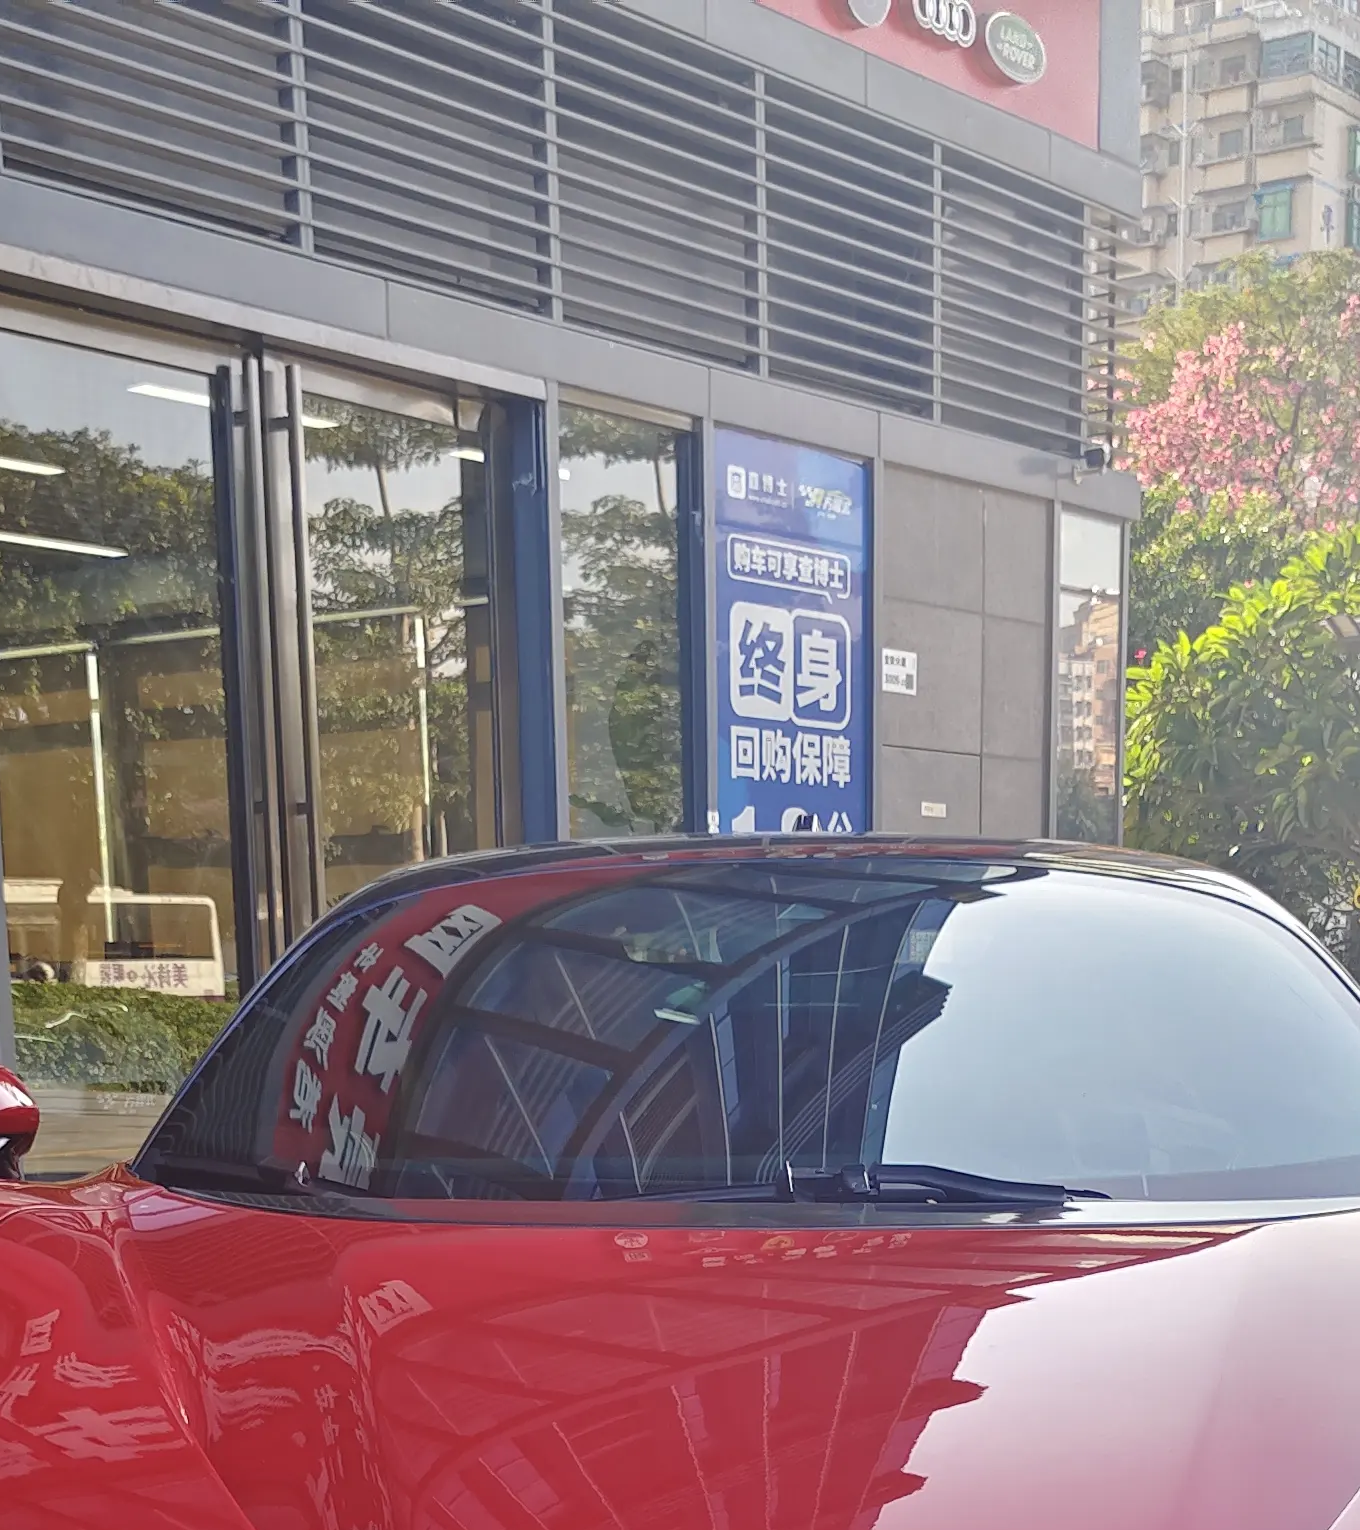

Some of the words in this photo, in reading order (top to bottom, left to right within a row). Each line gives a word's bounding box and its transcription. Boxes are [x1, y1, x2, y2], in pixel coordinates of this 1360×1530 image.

[733, 542, 845, 589] 购车可享查博士
[738, 619, 842, 711] 终身
[730, 725, 851, 788] 回购保障
